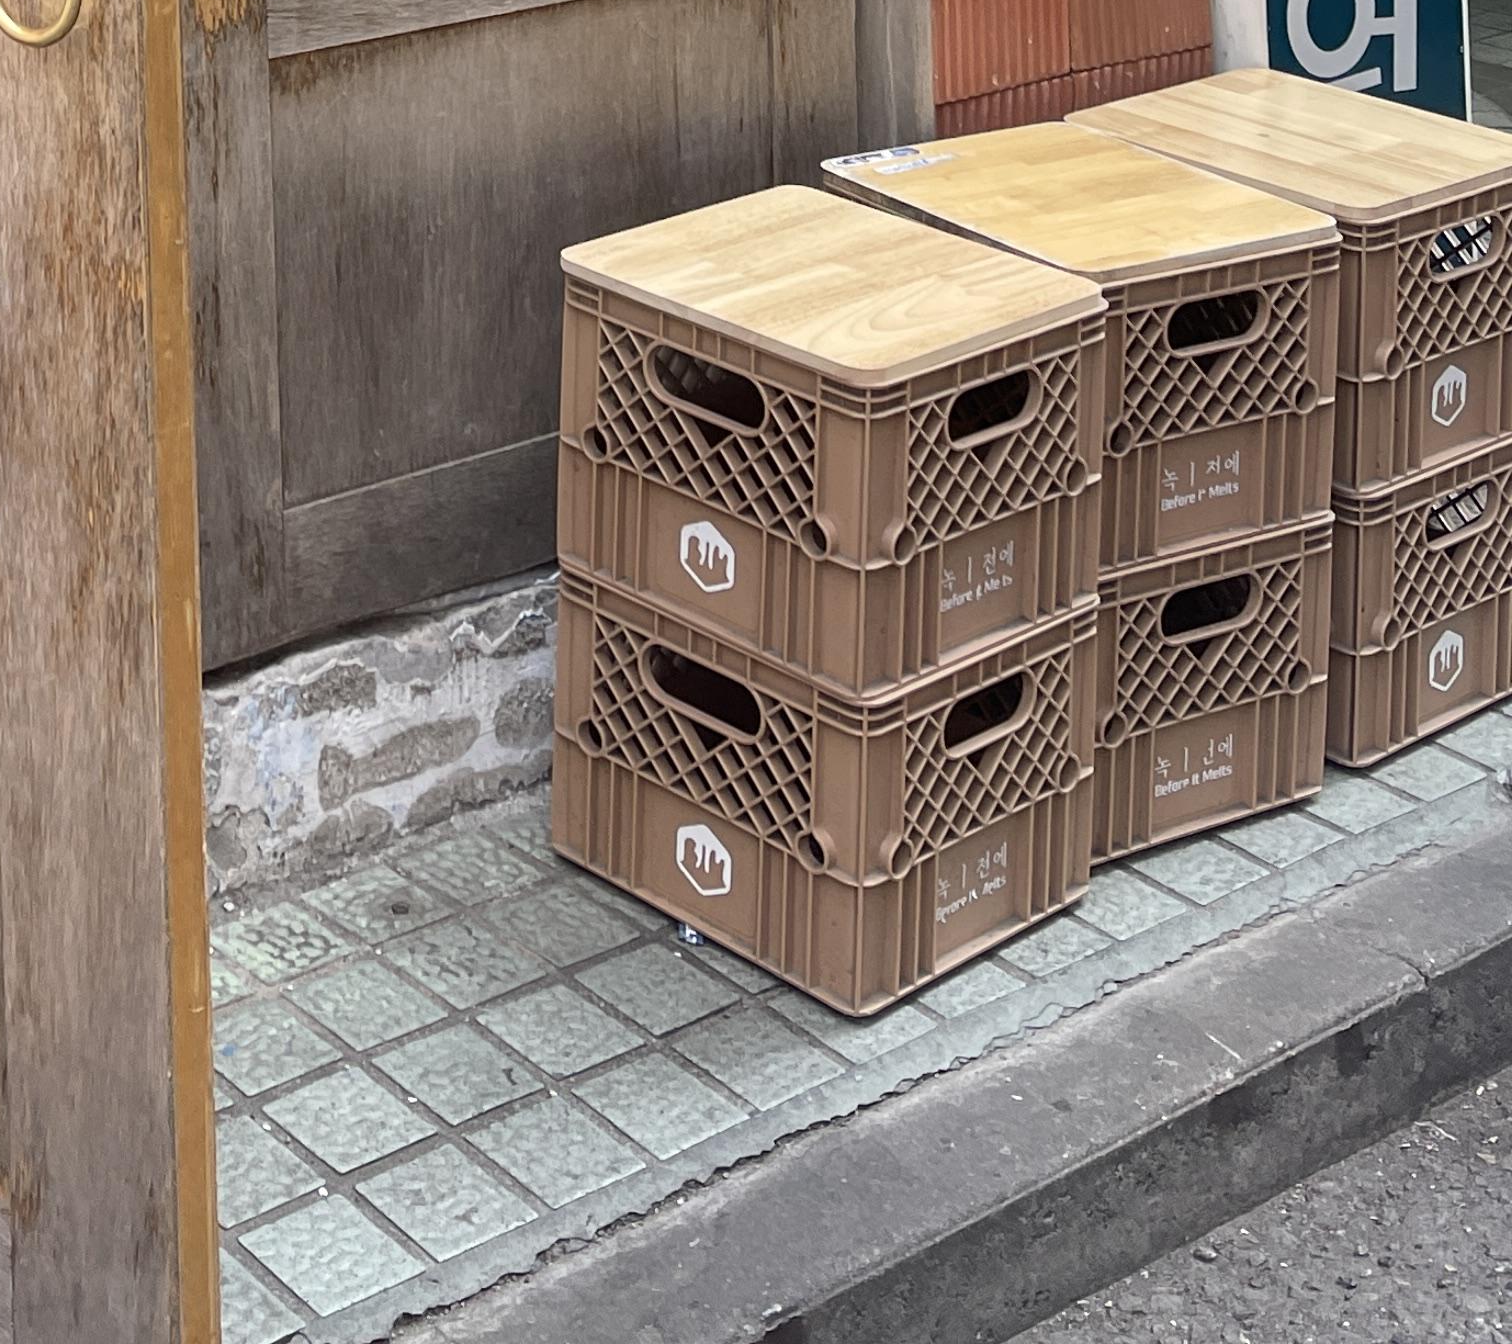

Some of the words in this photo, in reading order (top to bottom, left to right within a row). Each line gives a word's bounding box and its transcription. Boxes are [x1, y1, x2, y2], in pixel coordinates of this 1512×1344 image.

[1160, 493, 1196, 511] Before
[1208, 482, 1240, 499] Melts
[939, 590, 973, 612] Before
[1154, 778, 1190, 798] Before
[1202, 764, 1233, 783] Melts
